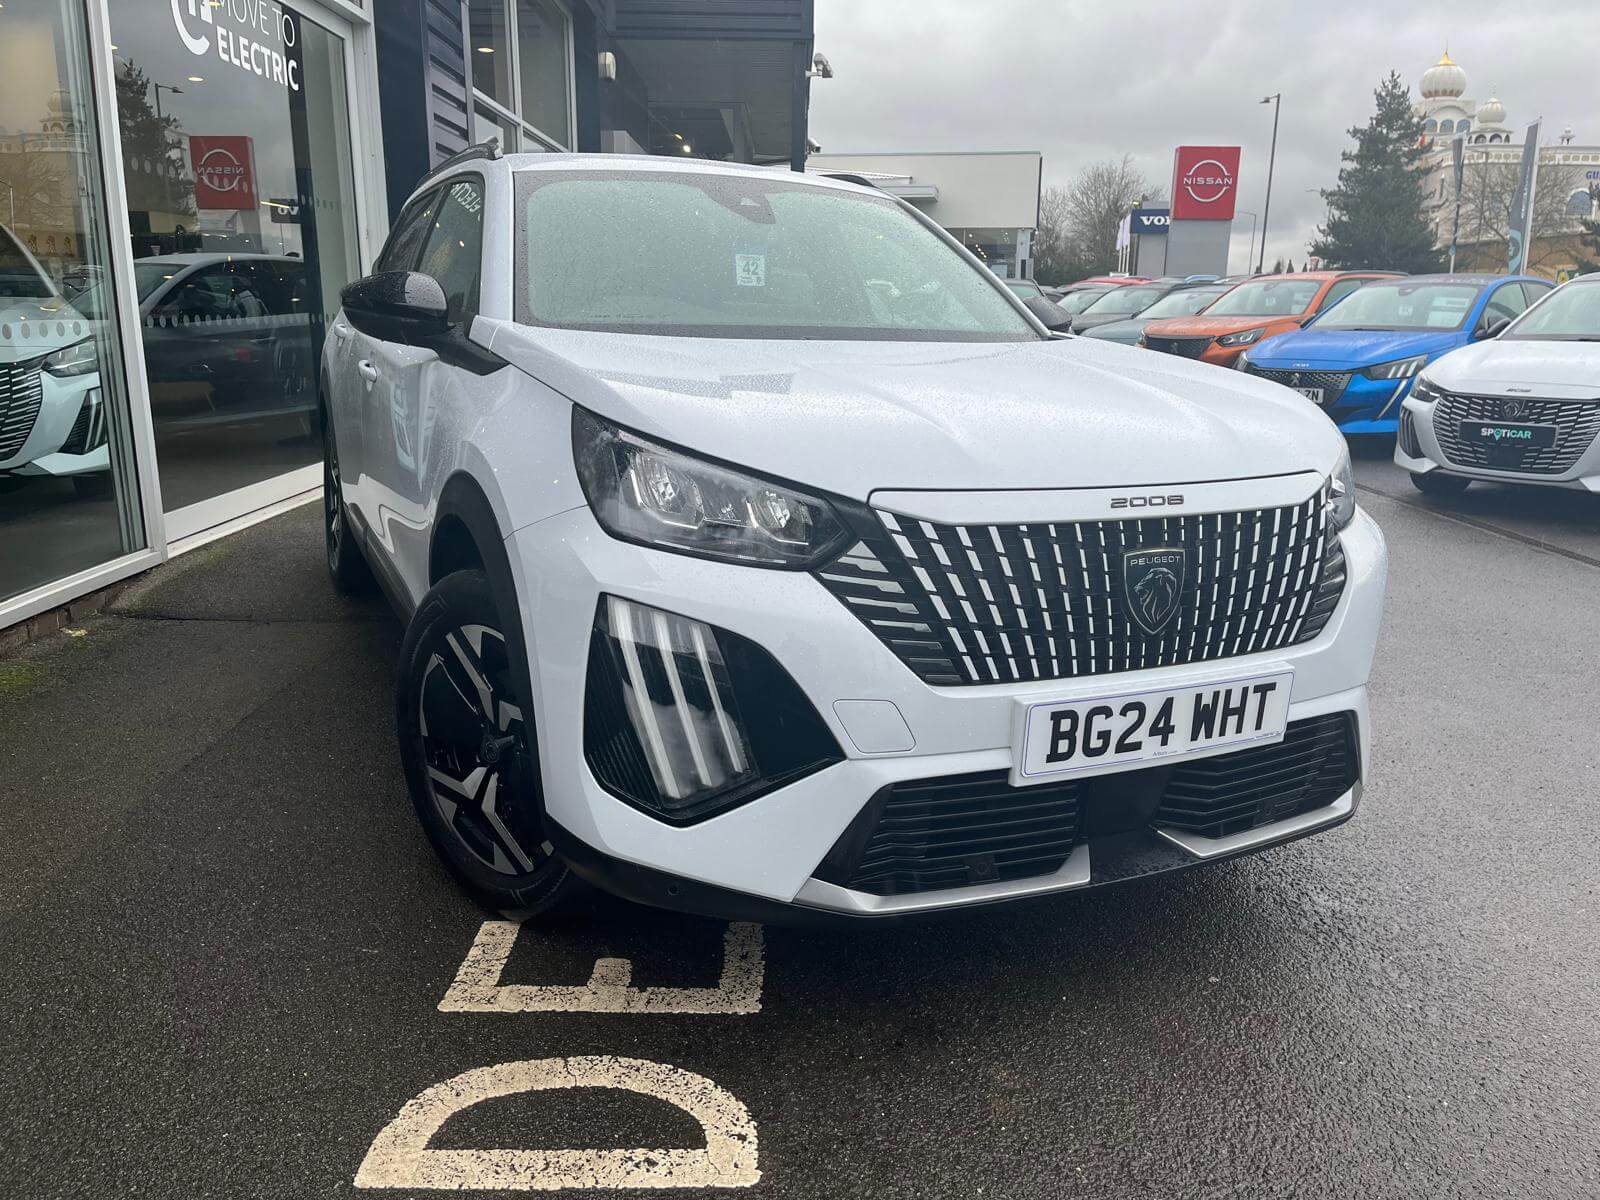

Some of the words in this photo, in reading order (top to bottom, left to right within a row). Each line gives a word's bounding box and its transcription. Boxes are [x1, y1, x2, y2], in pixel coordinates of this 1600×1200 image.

[272, 7, 295, 47] TO
[216, 25, 299, 91] ELECTRIC
[1183, 177, 1233, 185] NISSAN
[1110, 495, 1184, 509] 2008
[1130, 555, 1181, 566] PEUGEOT
[1046, 696, 1175, 763] BG24
[1190, 682, 1277, 742] WHT
